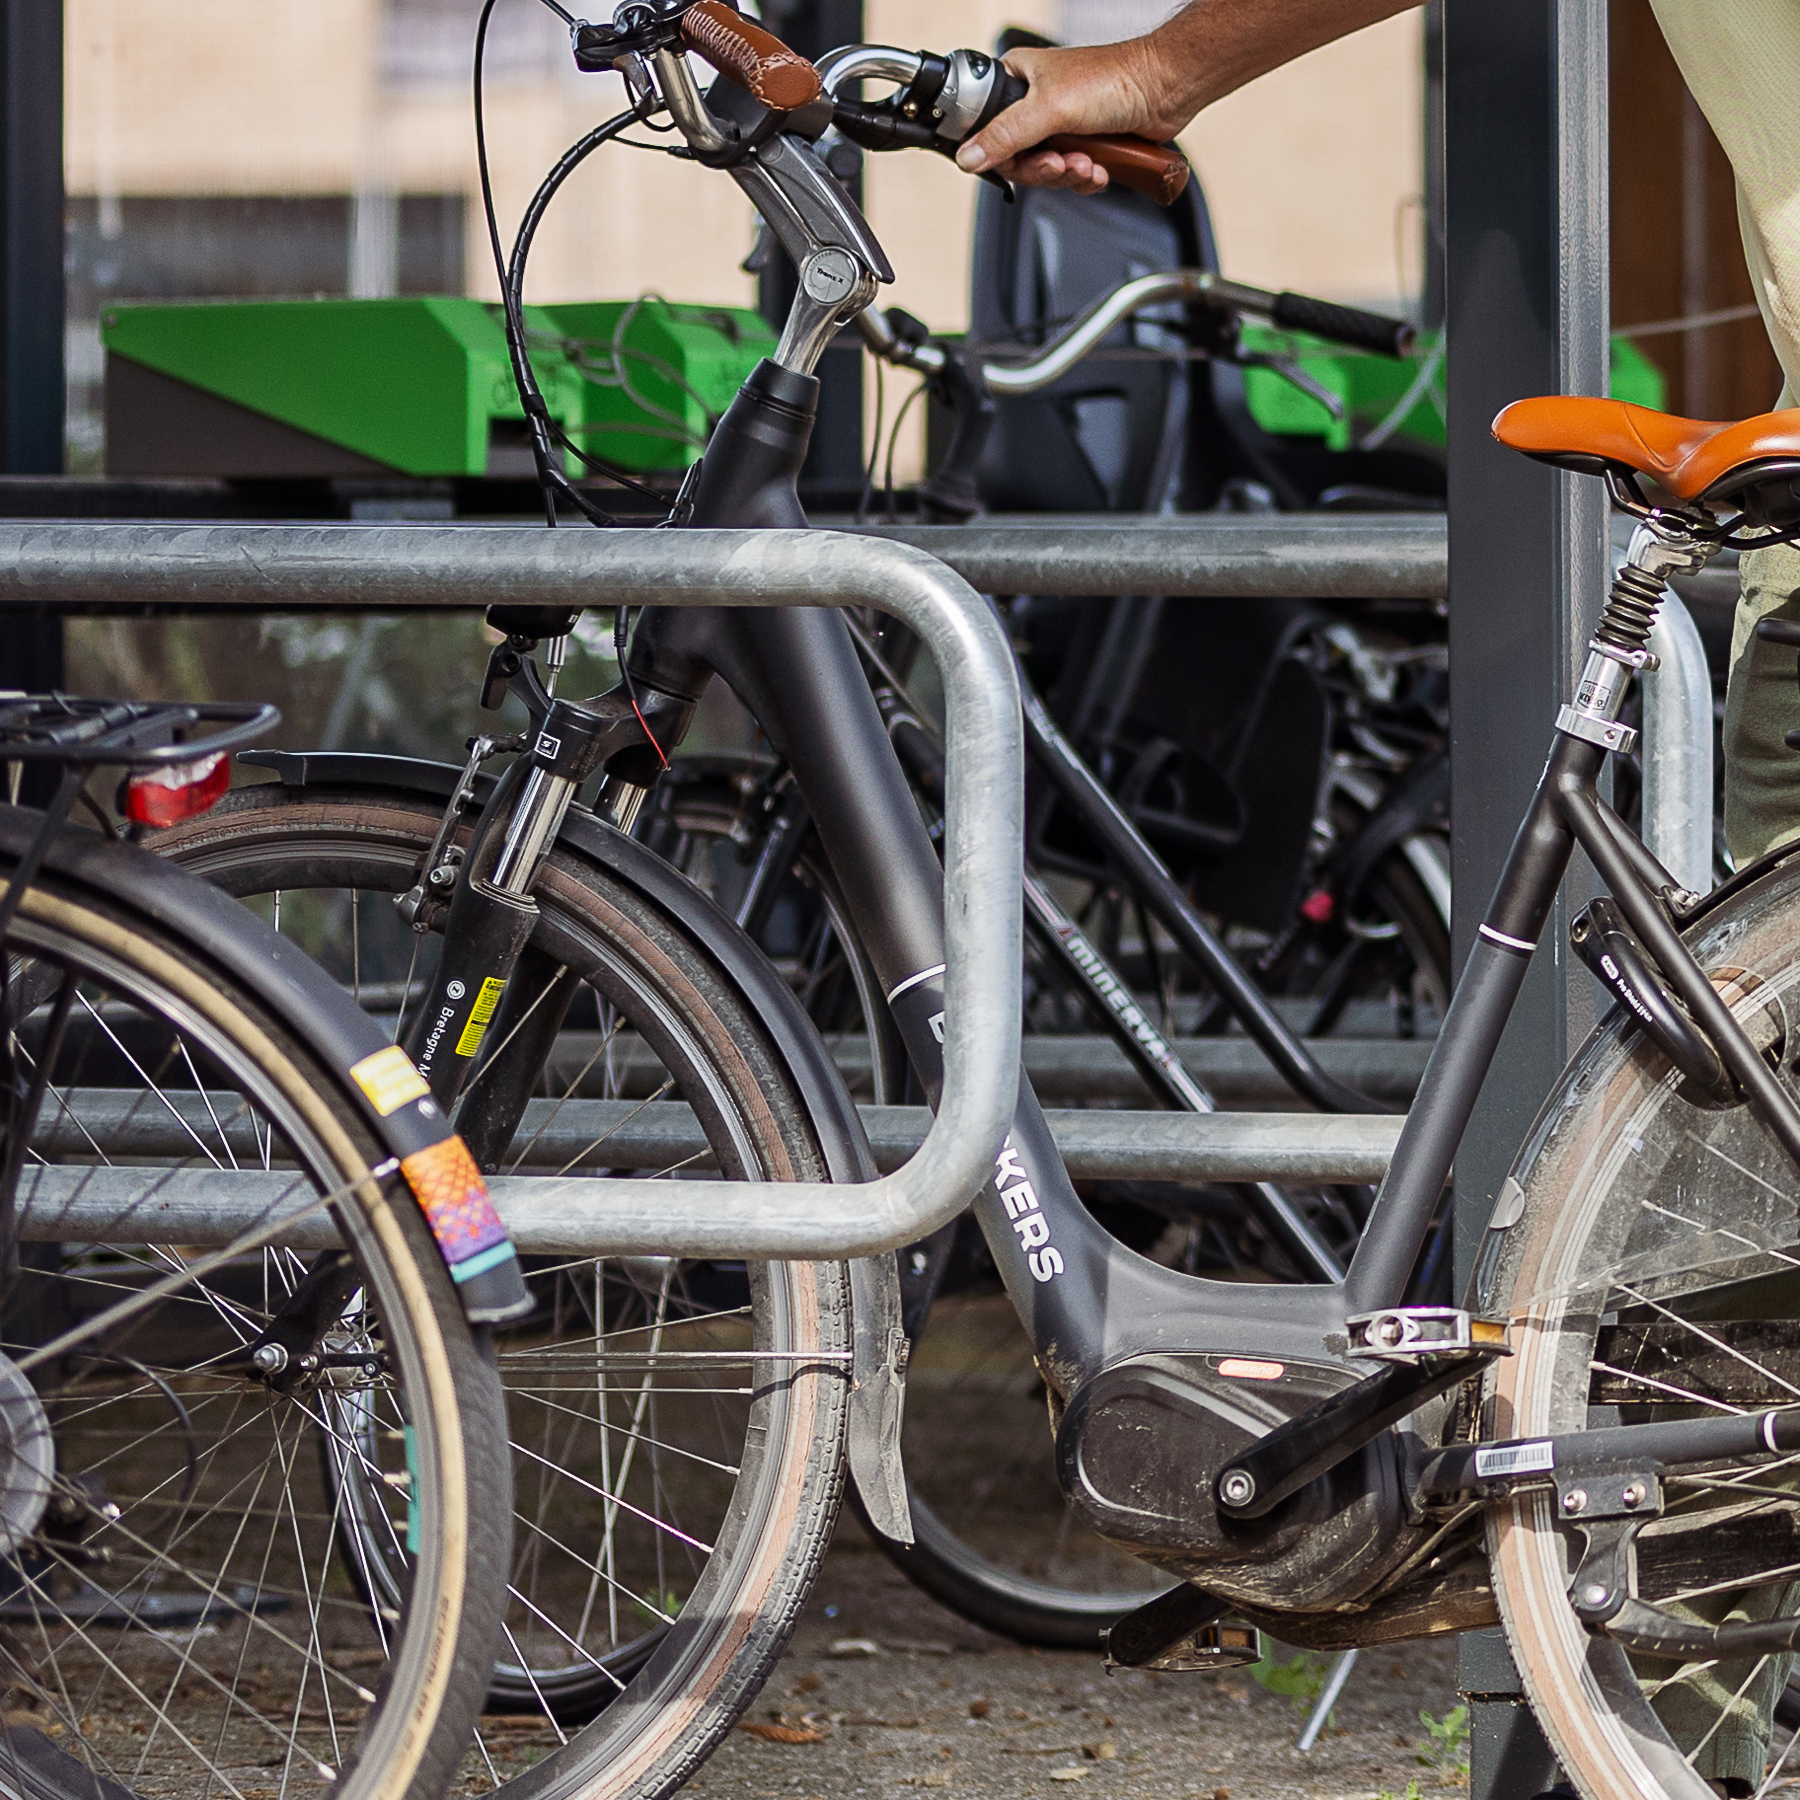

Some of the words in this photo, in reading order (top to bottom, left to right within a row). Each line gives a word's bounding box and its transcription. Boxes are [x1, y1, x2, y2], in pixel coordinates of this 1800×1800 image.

[422, 1007, 454, 1061] Bretagne
[417, 1063, 431, 1078] M
[995, 1140, 1064, 1283] KERS
